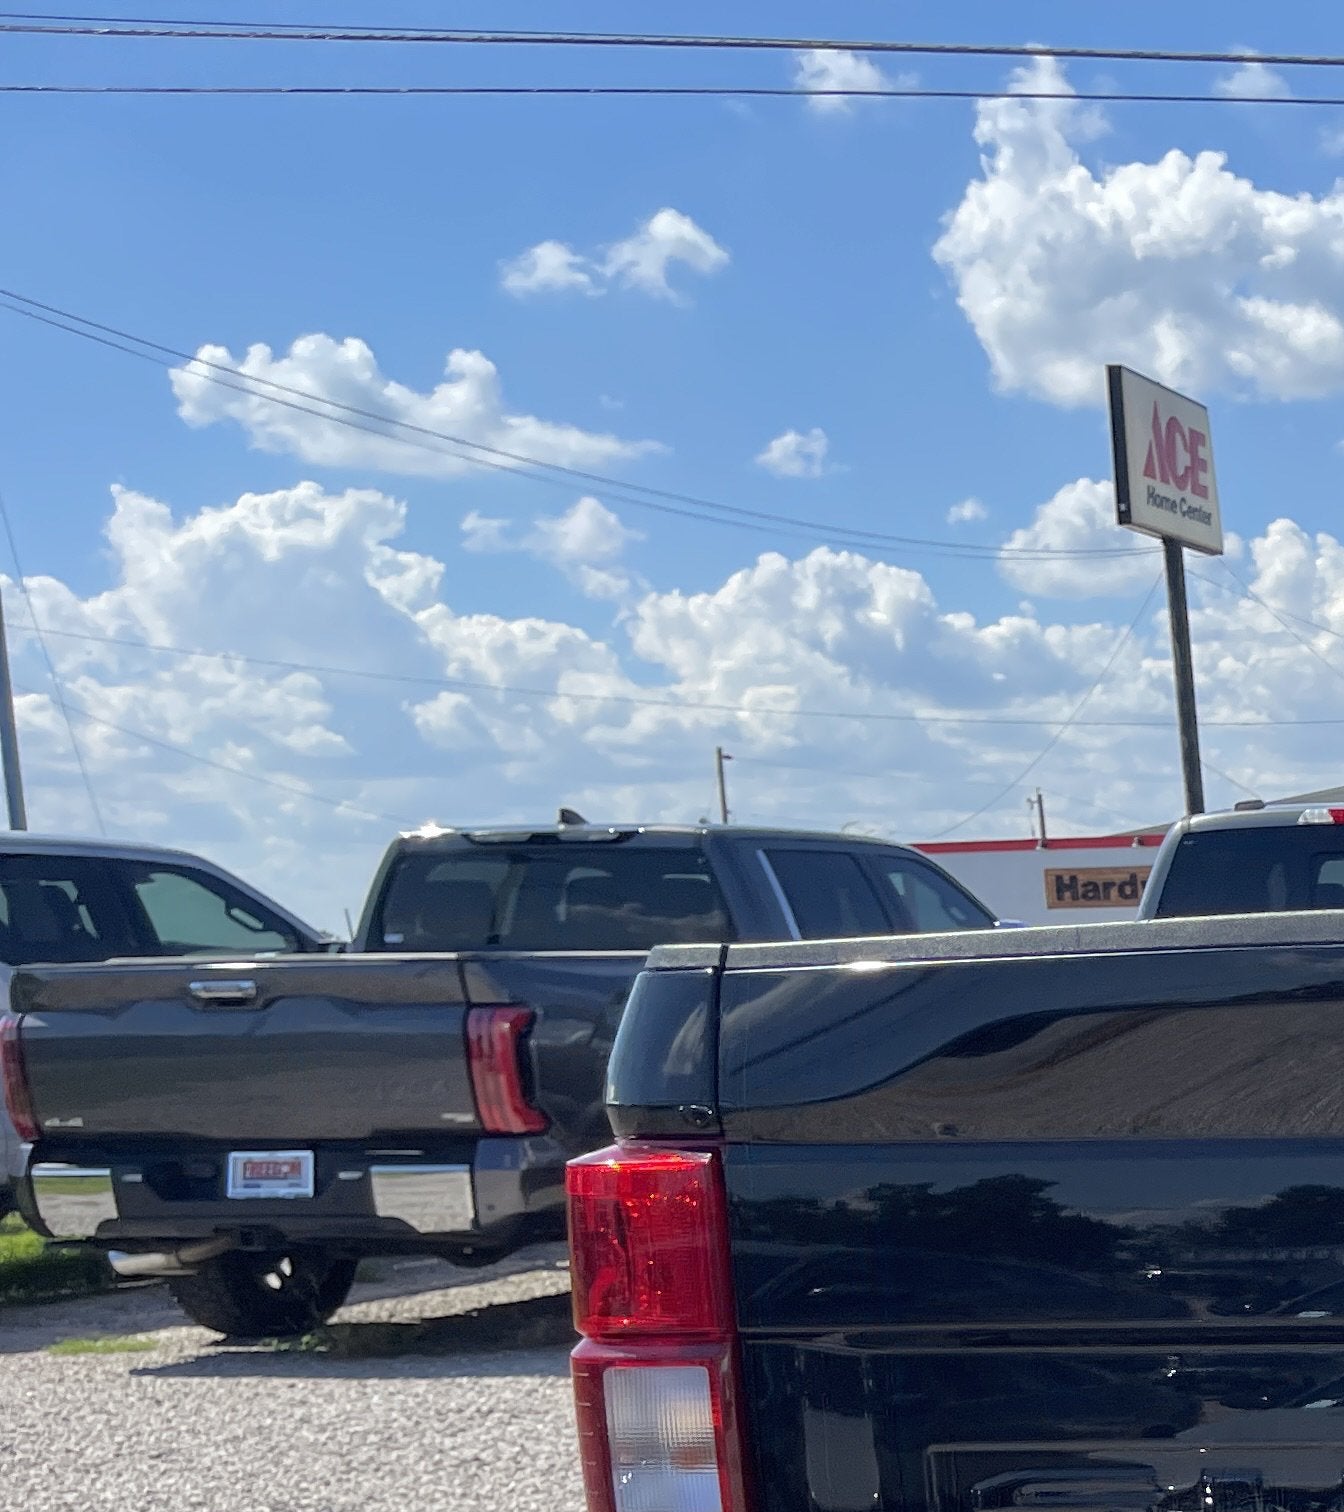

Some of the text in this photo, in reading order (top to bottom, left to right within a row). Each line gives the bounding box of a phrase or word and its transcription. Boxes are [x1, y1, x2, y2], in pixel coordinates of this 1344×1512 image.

[1142, 400, 1209, 500] ACE
[1146, 484, 1213, 527] Home Center
[1055, 872, 1147, 902] Hard
